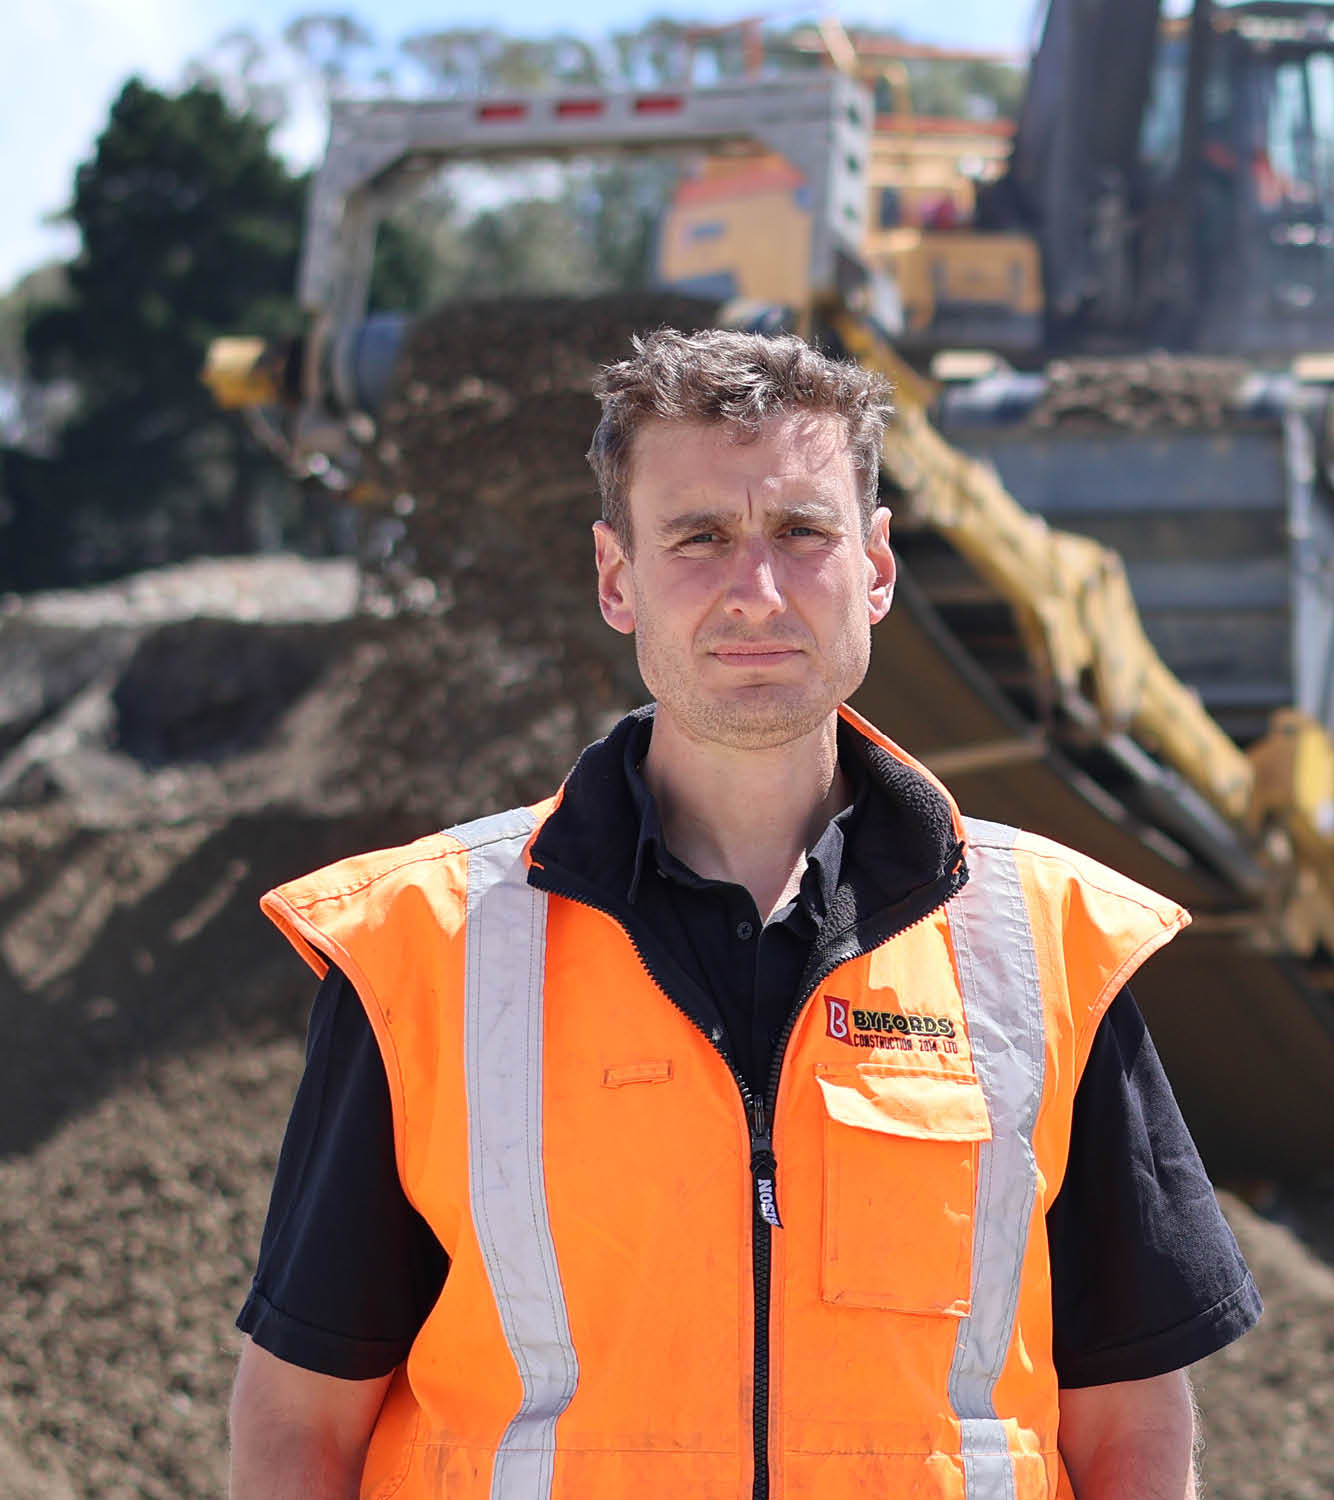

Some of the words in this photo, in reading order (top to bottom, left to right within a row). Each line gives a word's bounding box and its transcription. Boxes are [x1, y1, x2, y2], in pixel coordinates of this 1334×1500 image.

[852, 1010, 956, 1038] BYFORDS
[853, 1033, 913, 1050] CONSTRUCTION
[943, 1040, 959, 1054] LTD
